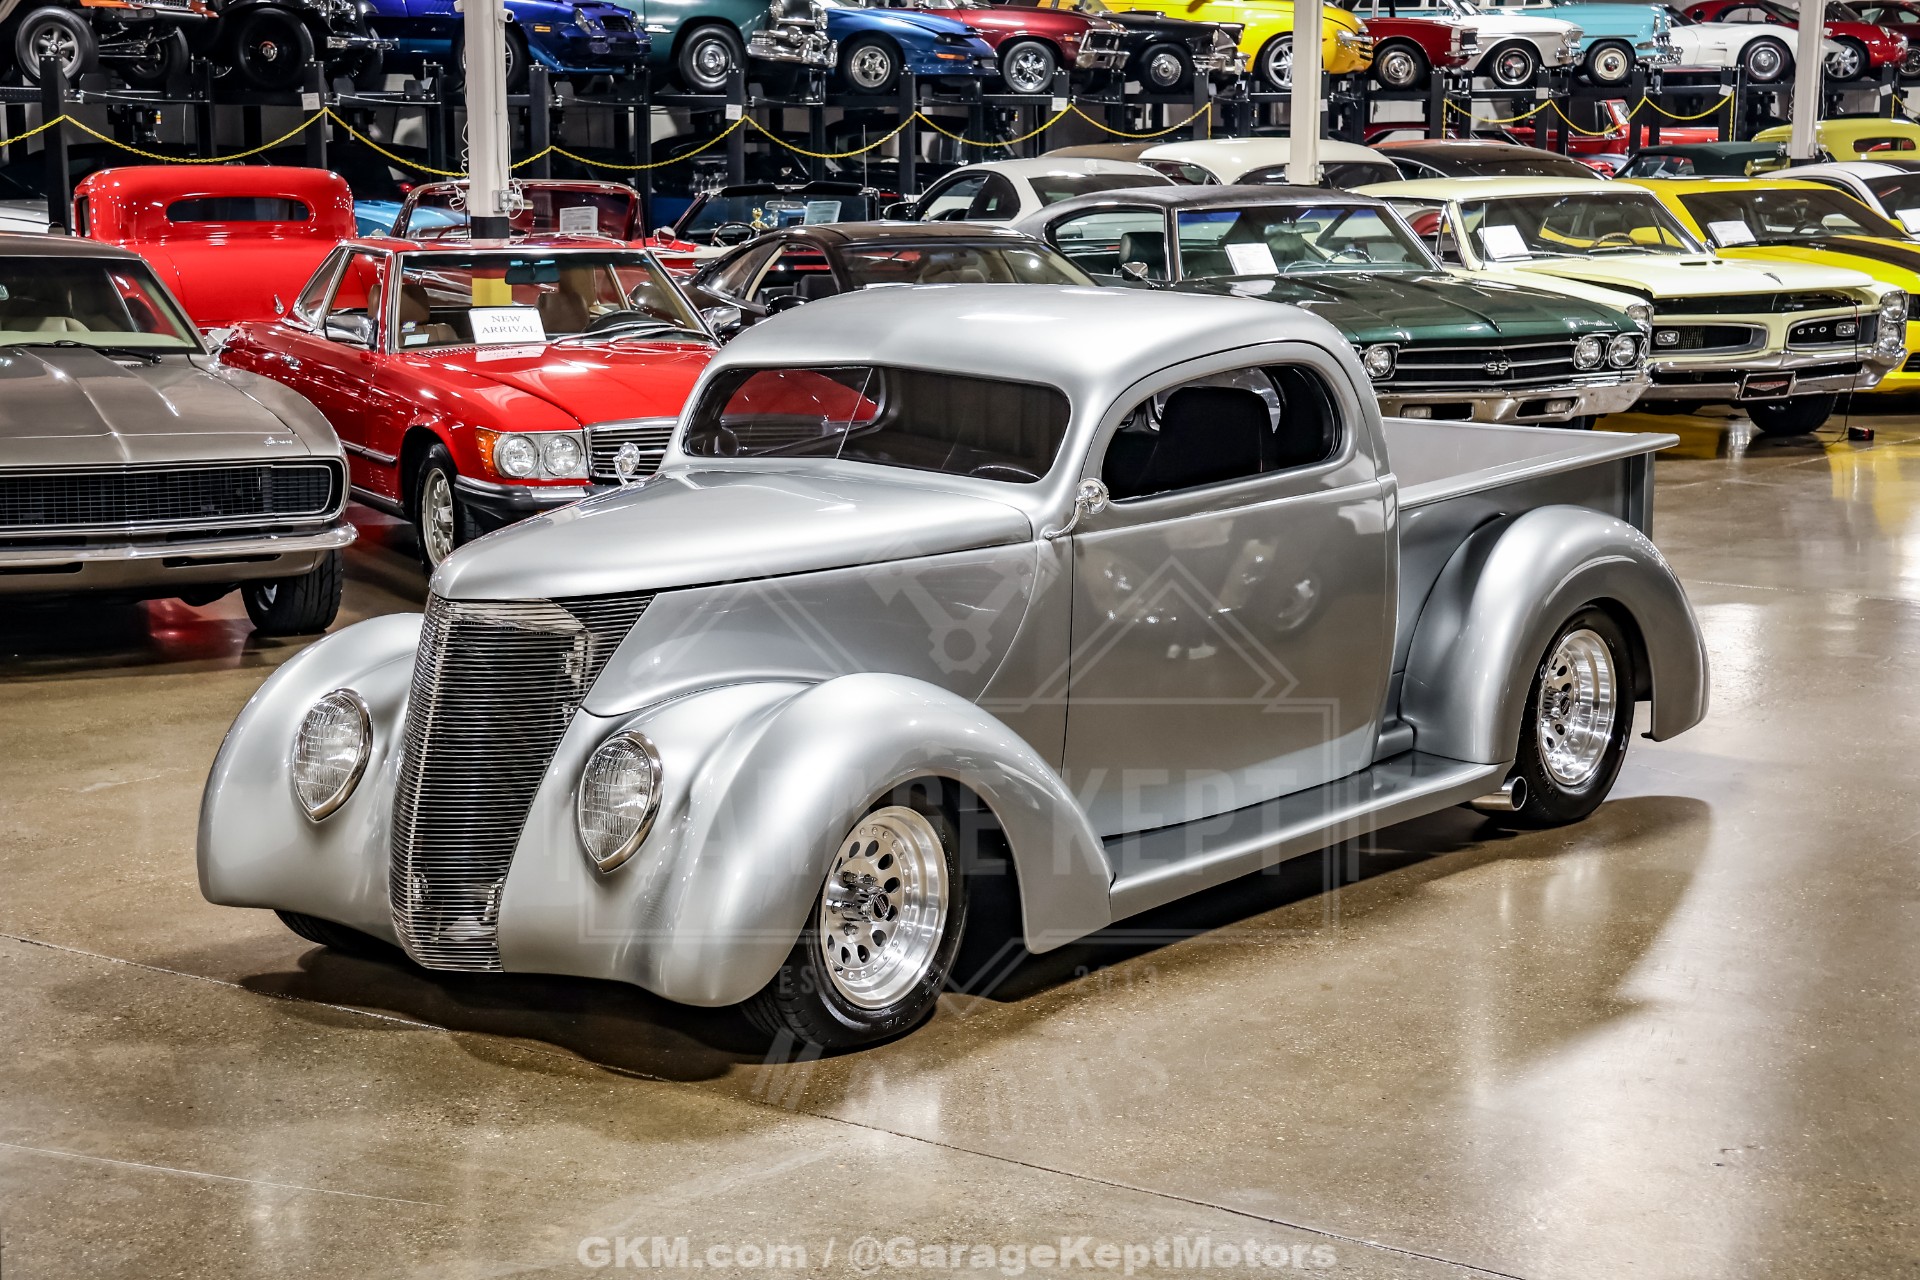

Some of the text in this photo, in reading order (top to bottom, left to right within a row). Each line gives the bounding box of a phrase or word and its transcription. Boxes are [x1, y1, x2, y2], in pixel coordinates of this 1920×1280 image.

[491, 315, 521, 323] NEW
[482, 325, 538, 334] ARRIVAL
[1797, 326, 1827, 335] GTO
[1486, 361, 1509, 372] SS
